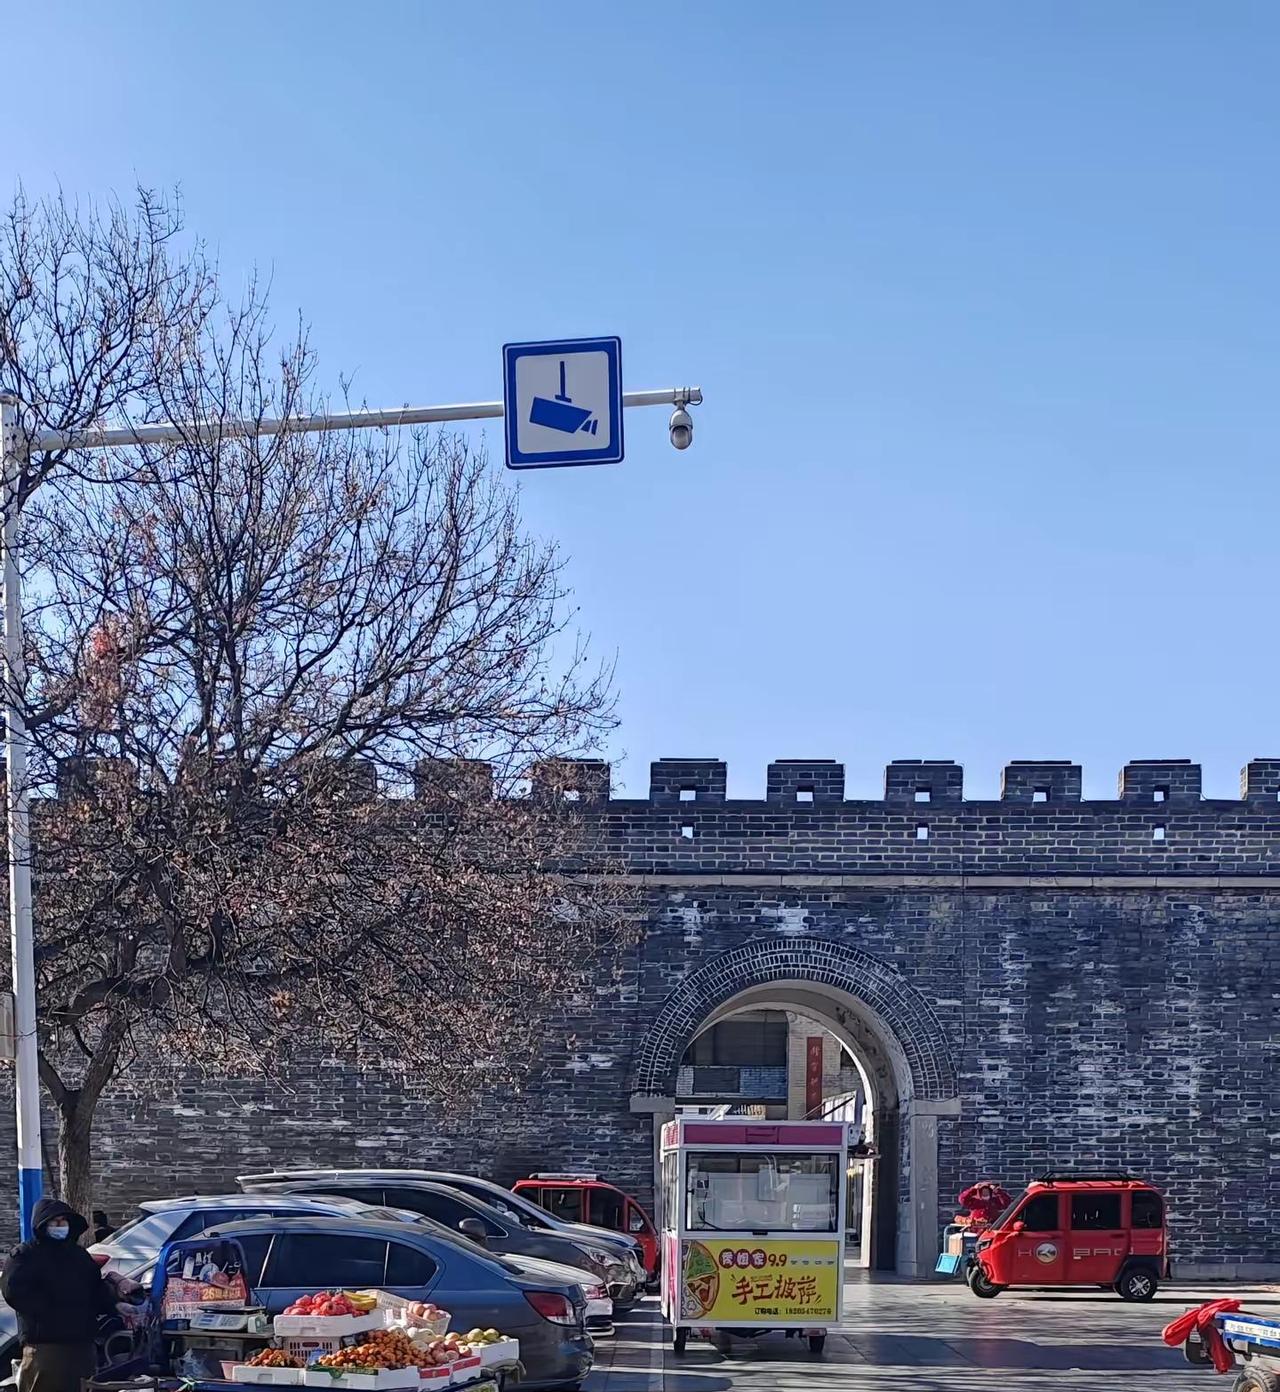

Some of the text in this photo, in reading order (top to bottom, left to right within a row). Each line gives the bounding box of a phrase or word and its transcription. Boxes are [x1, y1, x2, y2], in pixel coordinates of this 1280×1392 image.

[768, 1253, 788, 1267] 9.9
[731, 1274, 818, 1305] 手工披萨
